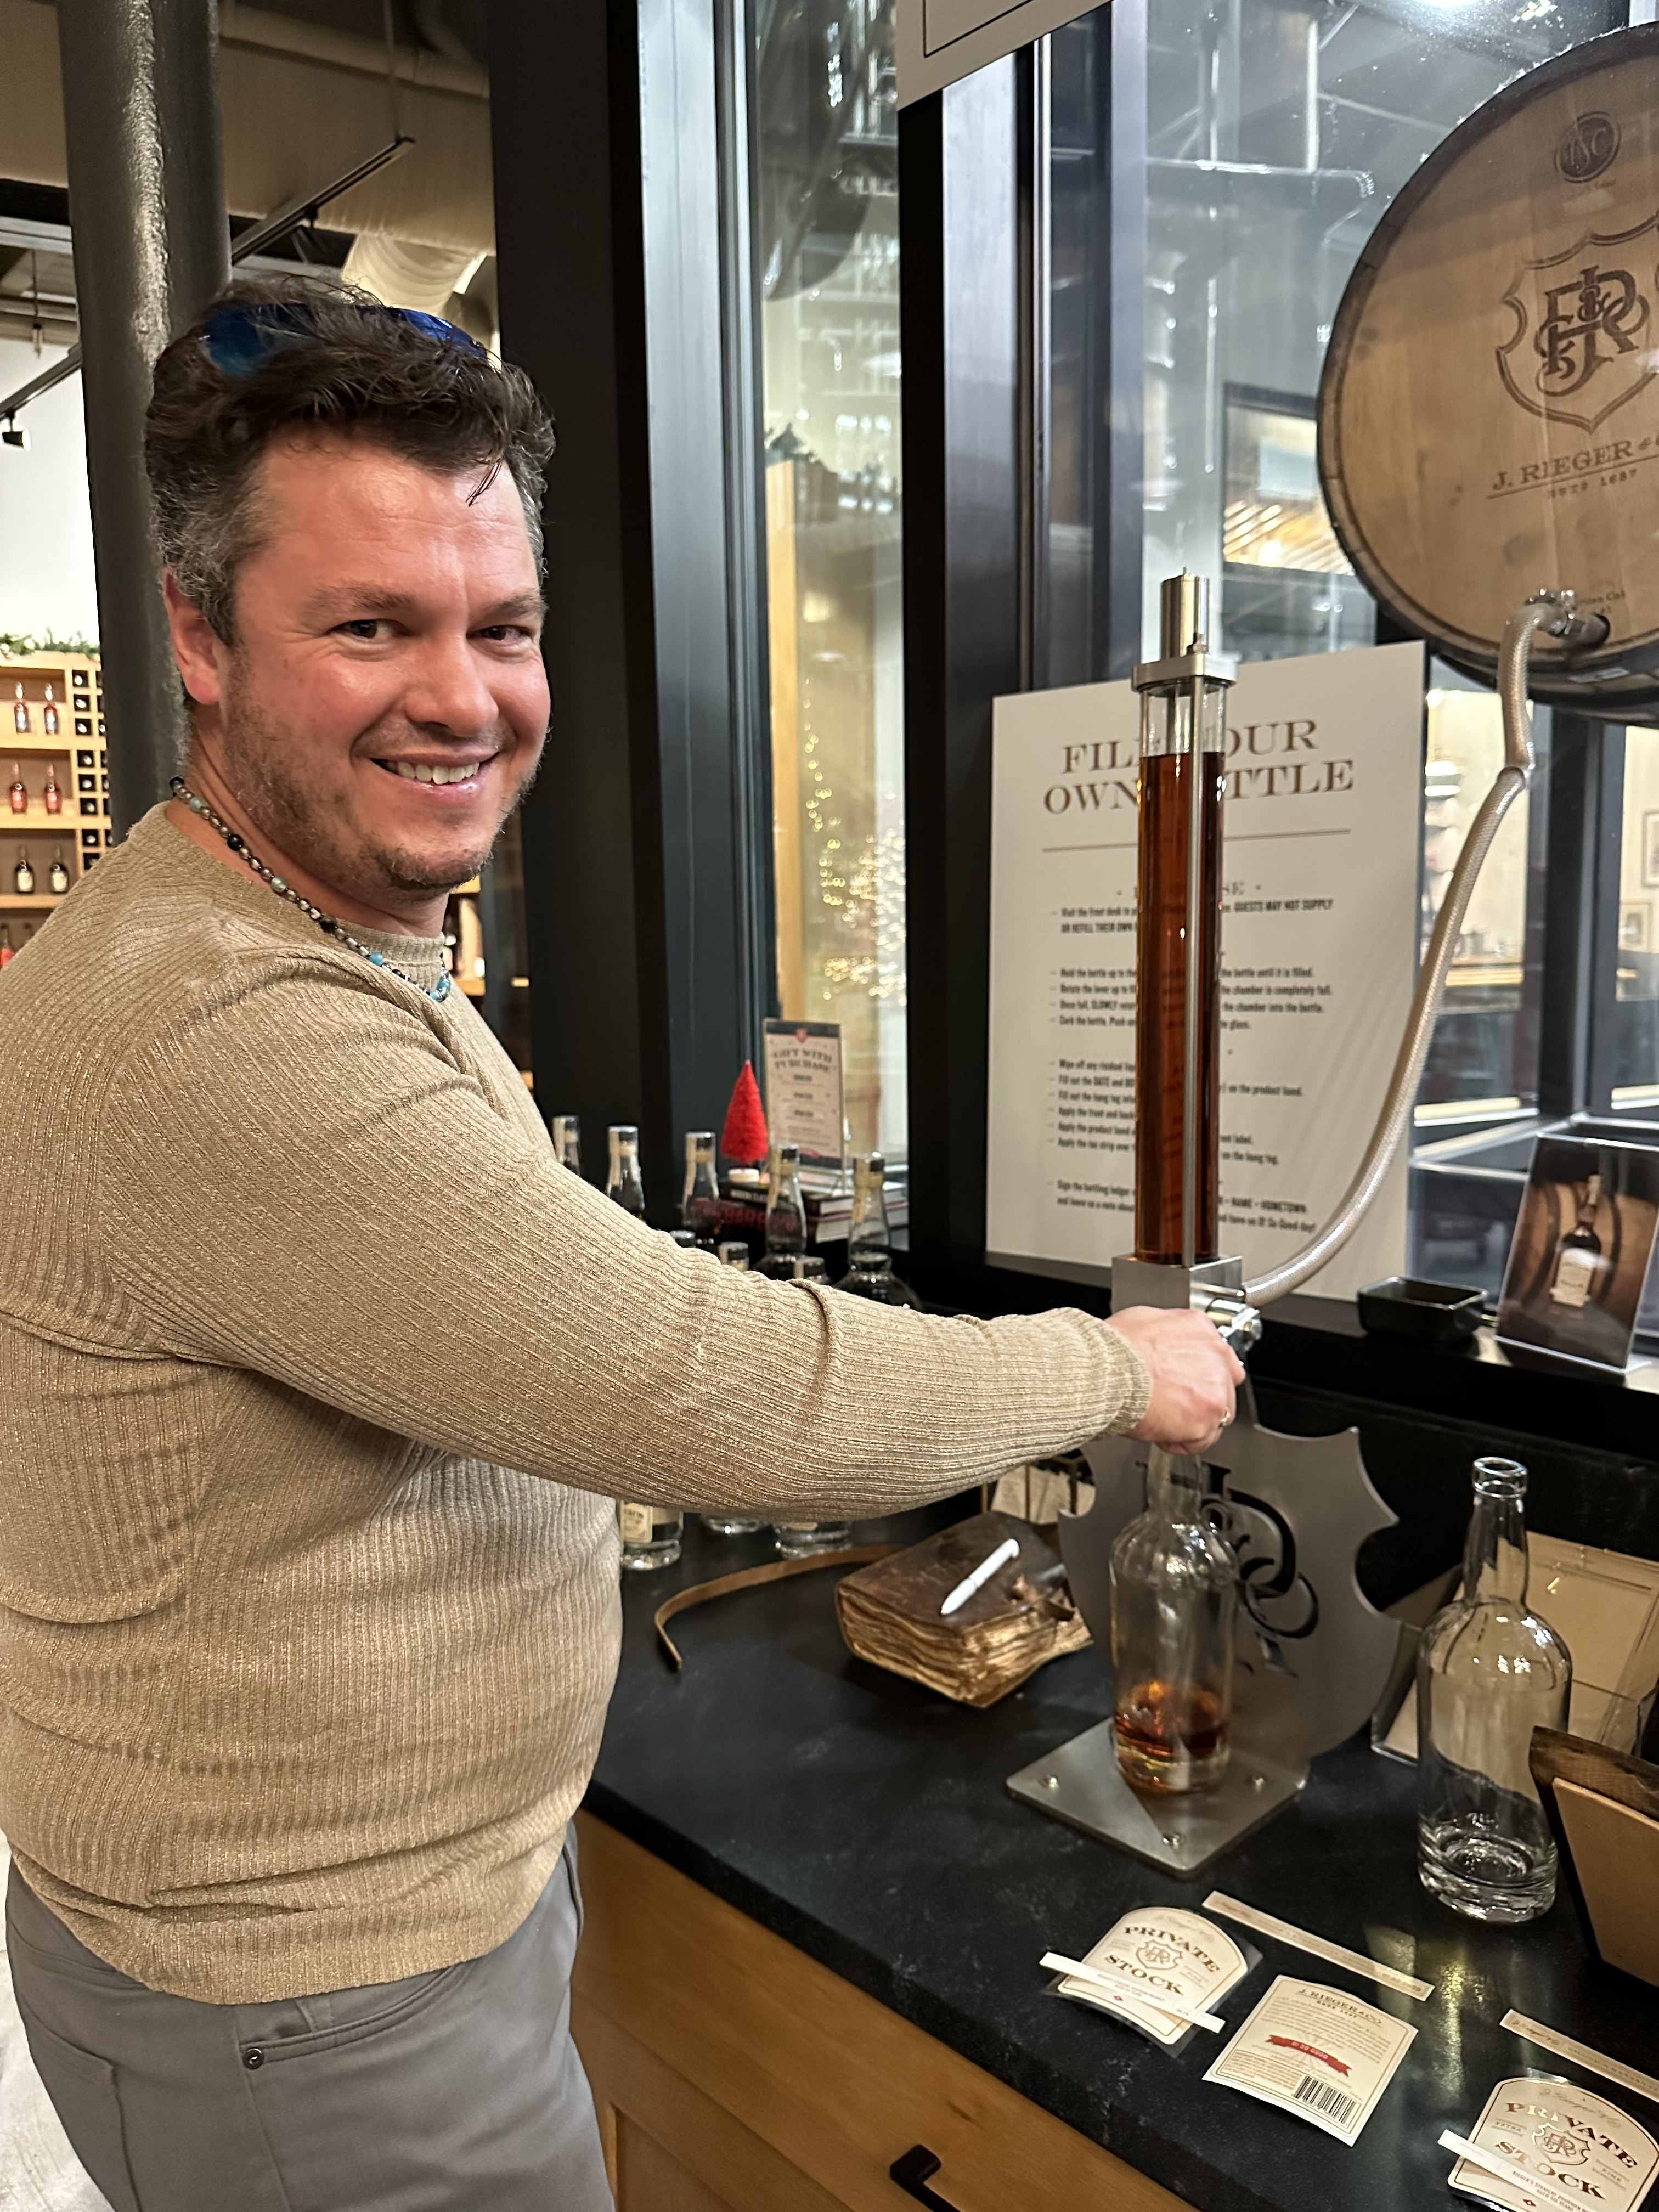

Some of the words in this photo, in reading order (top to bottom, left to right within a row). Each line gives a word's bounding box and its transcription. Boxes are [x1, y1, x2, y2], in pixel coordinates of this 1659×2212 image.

[1521, 439, 1633, 484] RIEGER
[1061, 738, 1139, 775] FIL
[1226, 719, 1319, 759] OUR
[1044, 779, 1138, 815] OWN
[1225, 759, 1353, 801] TTLE
[1079, 908, 1087, 917] the
[1234, 901, 1263, 912] GUESTS
[1266, 901, 1282, 911] MAY
[1302, 899, 1334, 911] SUPPLY
[1096, 923, 1115, 933] THEIR
[1117, 923, 1132, 932] OWN
[1060, 969, 1074, 978] Hold
[1077, 969, 1086, 978] the
[1088, 969, 1106, 978] bottle
[1109, 970, 1116, 979] up
[1118, 969, 1124, 978] to
[1234, 968, 1255, 978] bottle
[1257, 968, 1274, 978] until
[1277, 968, 1282, 978] it
[1284, 968, 1290, 978] is
[1293, 967, 1313, 978] filled.
[1060, 984, 1080, 994] Rotate
[1083, 985, 1092, 994] the
[1111, 986, 1119, 994] up
[1233, 986, 1263, 995] chamber
[1273, 985, 1314, 997] completely
[1317, 985, 1331, 995] full.
[1091, 1000, 1118, 1010] SLOWLY
[1223, 1003, 1233, 1012] the
[1235, 1003, 1266, 1012] chamber
[1269, 1003, 1283, 1012] into
[1286, 1003, 1297, 1012] the
[1300, 1003, 1323, 1013] bottle.
[1076, 1017, 1086, 1025] the
[1230, 1019, 1249, 1030] glass.
[1059, 1059, 1074, 1070] Wipe
[1076, 1060, 1084, 1069] off
[1087, 1062, 1097, 1071] any
[1059, 1074, 1069, 1084] Fill
[1070, 1077, 1080, 1085] out
[1082, 1076, 1092, 1086] the
[1094, 1076, 1109, 1087] DATE
[1112, 1079, 1122, 1087] and
[1240, 1084, 1250, 1094] the
[1252, 1085, 1280, 1096] product
[1283, 1086, 1302, 1097] band.
[1059, 1090, 1069, 1100] Fill
[1070, 1093, 1080, 1101] out
[1082, 1092, 1091, 1101] the
[1093, 1093, 1108, 1104] hang
[1111, 1095, 1120, 1105] tag
[1059, 1107, 1075, 1118] Apply
[1077, 1107, 1087, 1116] the
[1089, 1108, 1104, 1118] front
[1106, 1110, 1117, 1119] and
[1059, 1122, 1075, 1132] Apply
[1077, 1123, 1087, 1132] the
[1088, 1125, 1112, 1134] product
[1115, 1126, 1130, 1135] band
[1233, 1134, 1252, 1145] label.
[1058, 1137, 1075, 1148] Apply
[1077, 1138, 1086, 1148] the
[1099, 1141, 1115, 1152] strip
[1116, 1143, 1130, 1151] over
[1233, 1151, 1244, 1161] the
[1245, 1152, 1263, 1165] hang
[1058, 1180, 1071, 1192] Sign
[1074, 1182, 1082, 1191] the
[1084, 1183, 1108, 1197] bottling
[1110, 1186, 1130, 1197] ledger
[1232, 1198, 1252, 1209] NAME
[1261, 1199, 1307, 1213] HOMETOWN
[1057, 1197, 1068, 1205] and
[1070, 1198, 1086, 1206] leave
[1229, 1215, 1245, 1225] have
[1268, 1217, 1277, 1228] So
[1279, 1217, 1298, 1230] Good
[1300, 1222, 1316, 1233] day!
[1123, 1926, 1221, 1973] PRIVATE
[1104, 1954, 1184, 1996] STOCK
[1494, 2121, 1523, 2133] EXTRA
[1505, 2102, 1638, 2169] PRIVATE
[1493, 2141, 1605, 2200] STOCK
